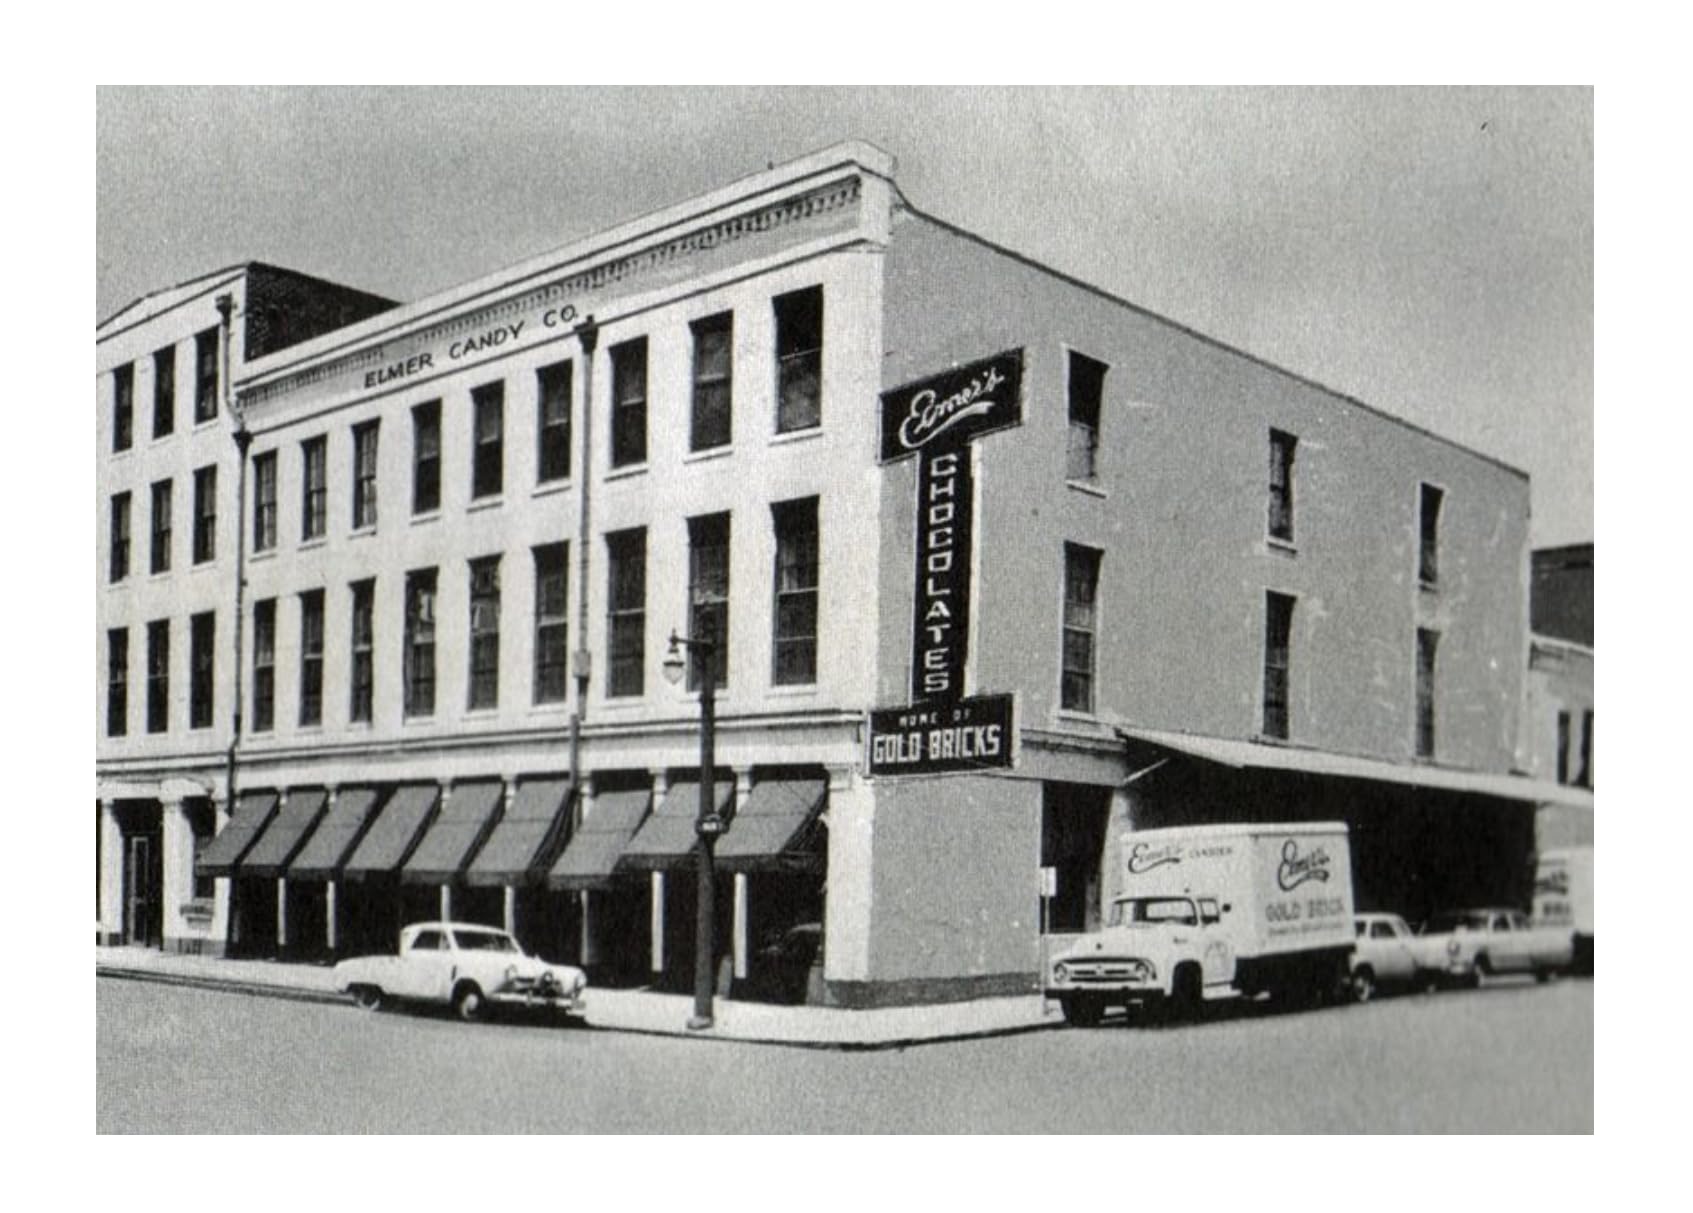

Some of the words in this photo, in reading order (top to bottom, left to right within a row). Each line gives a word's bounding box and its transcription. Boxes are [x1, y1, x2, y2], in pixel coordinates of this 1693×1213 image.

[364, 353, 434, 389] ELMER
[450, 321, 525, 360] CANDY
[543, 304, 579, 328] CO.
[898, 366, 1005, 449] Elmer's
[924, 453, 958, 692] CHOCOLATES
[872, 732, 922, 764] GOLD
[928, 724, 1001, 760] BRICKS
[899, 711, 939, 727] HOME
[953, 708, 971, 721] OF
